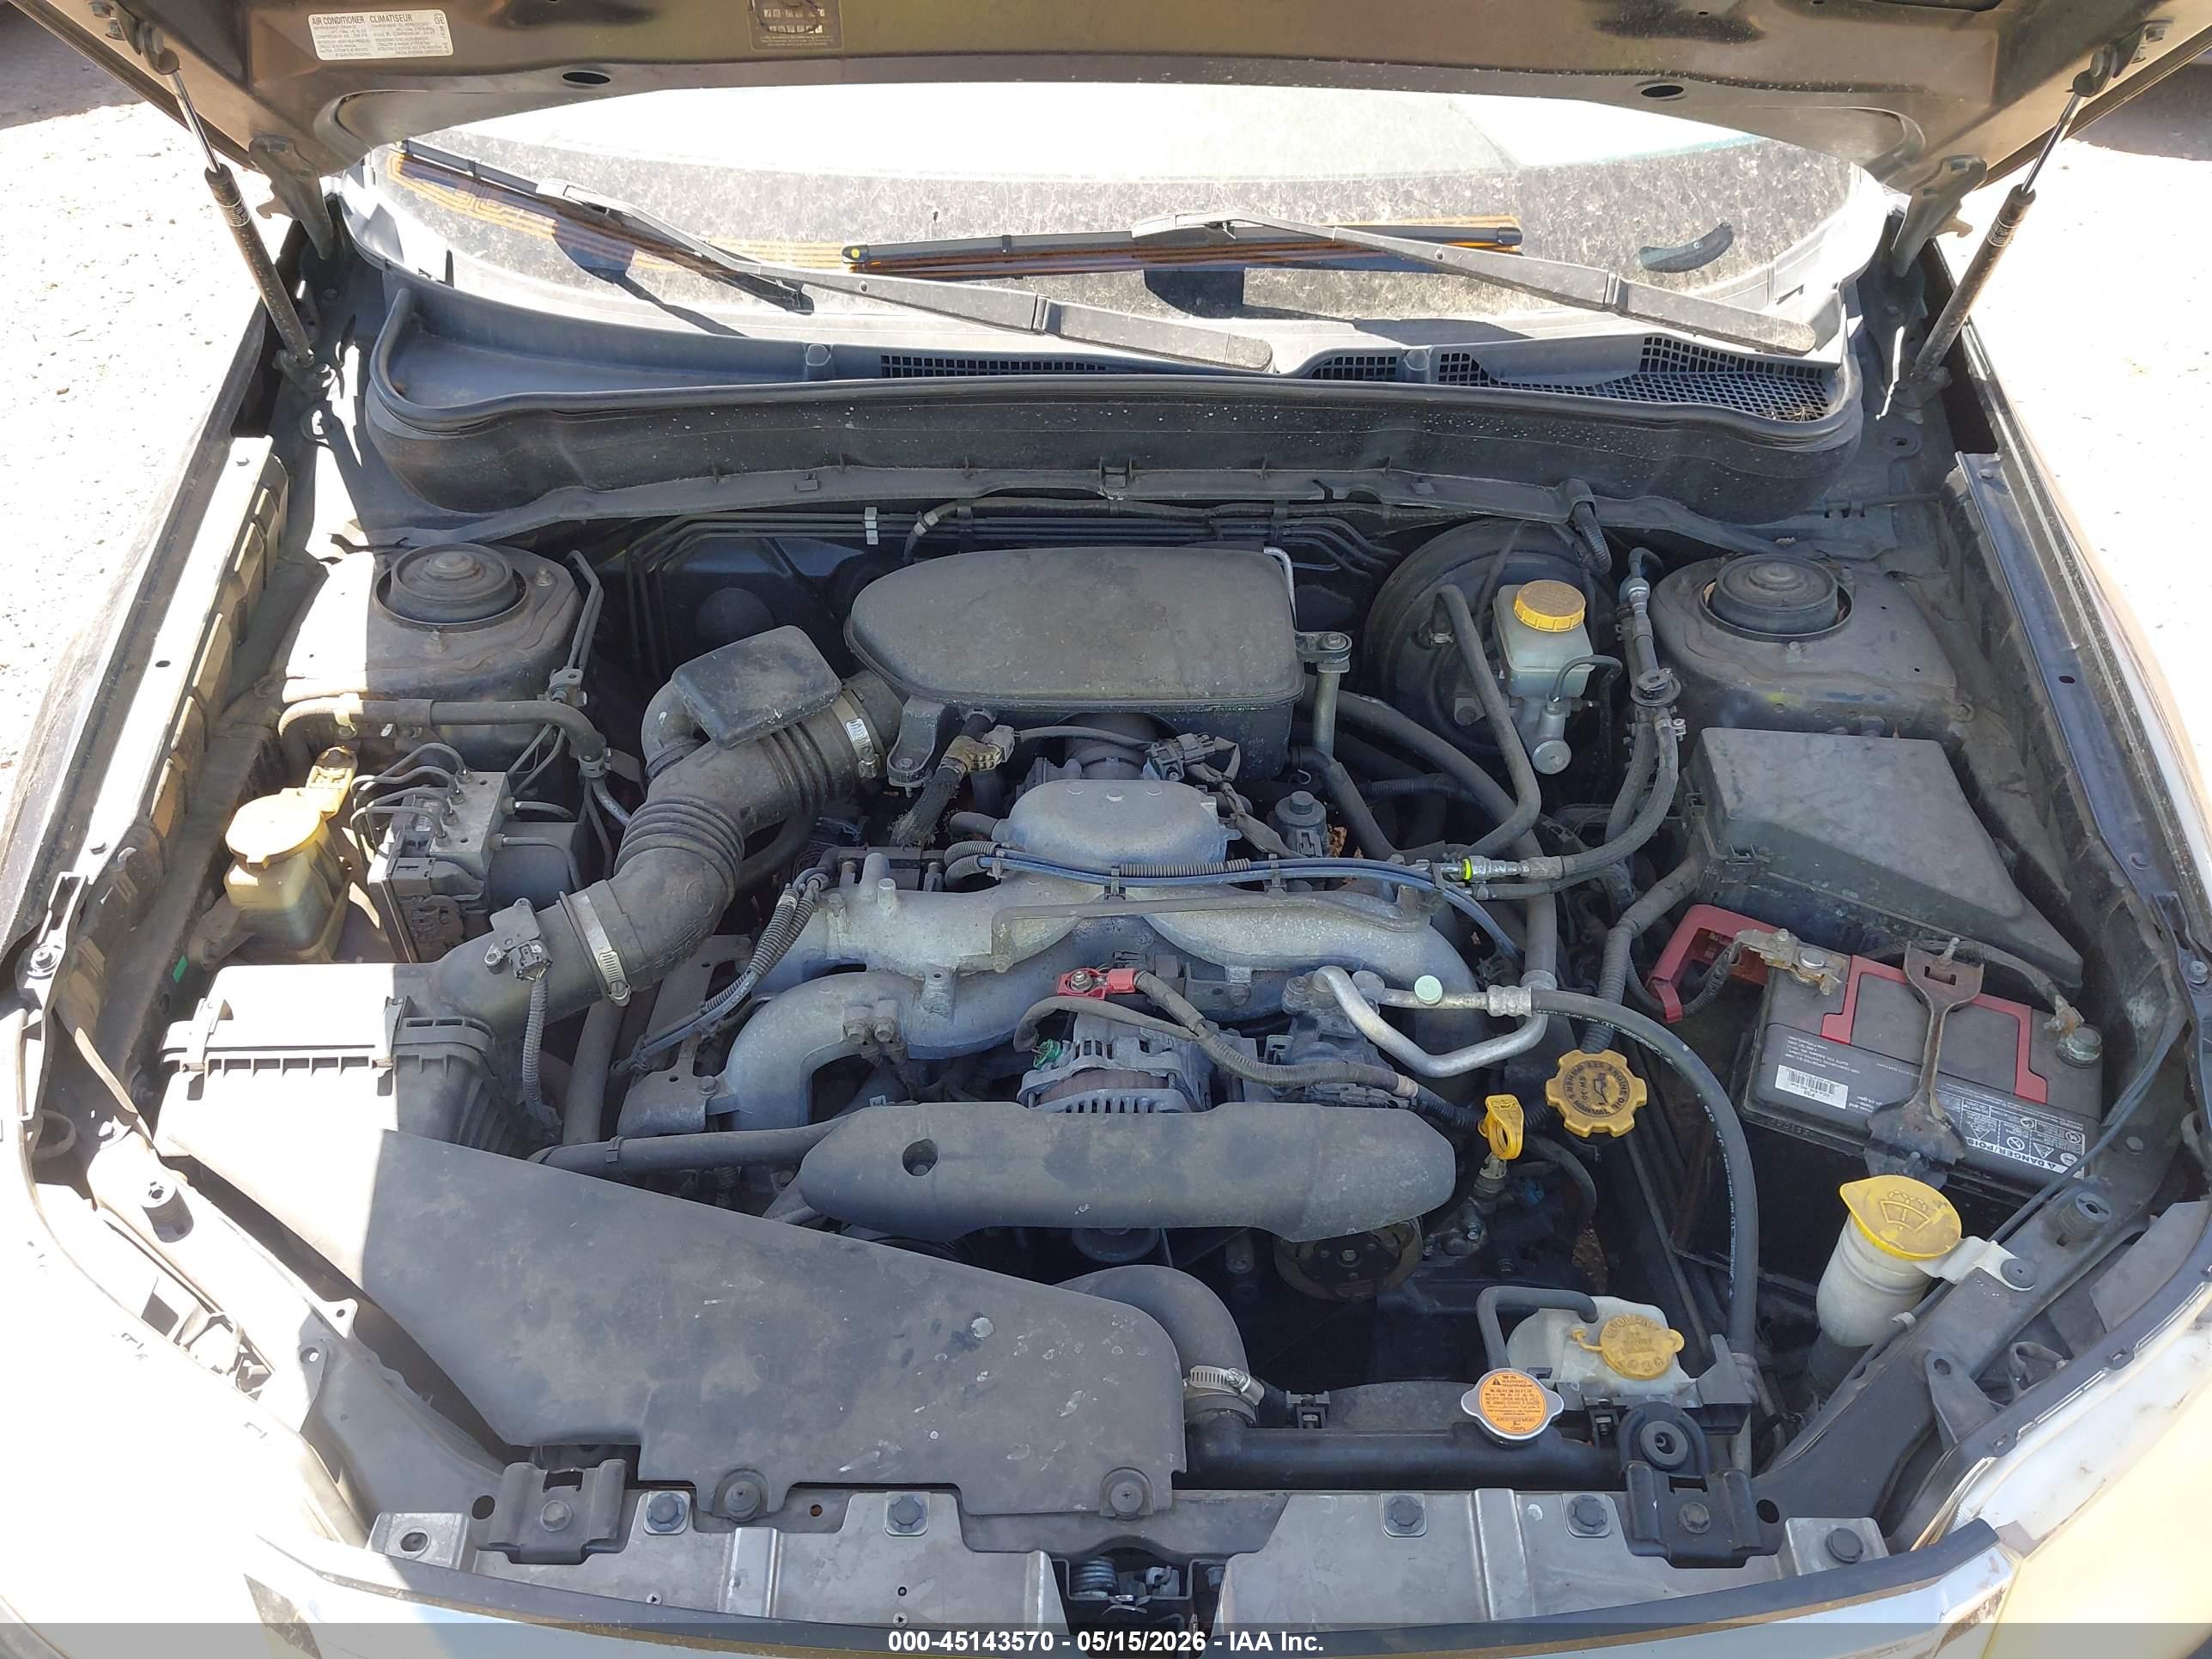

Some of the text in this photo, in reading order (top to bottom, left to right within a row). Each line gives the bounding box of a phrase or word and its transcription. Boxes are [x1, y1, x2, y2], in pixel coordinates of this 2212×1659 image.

[312, 15, 365, 25] AIR CONDITIONER
[369, 14, 413, 24] CLIMATISEUR
[1607, 1065, 1628, 1109] ENGINE OIL
